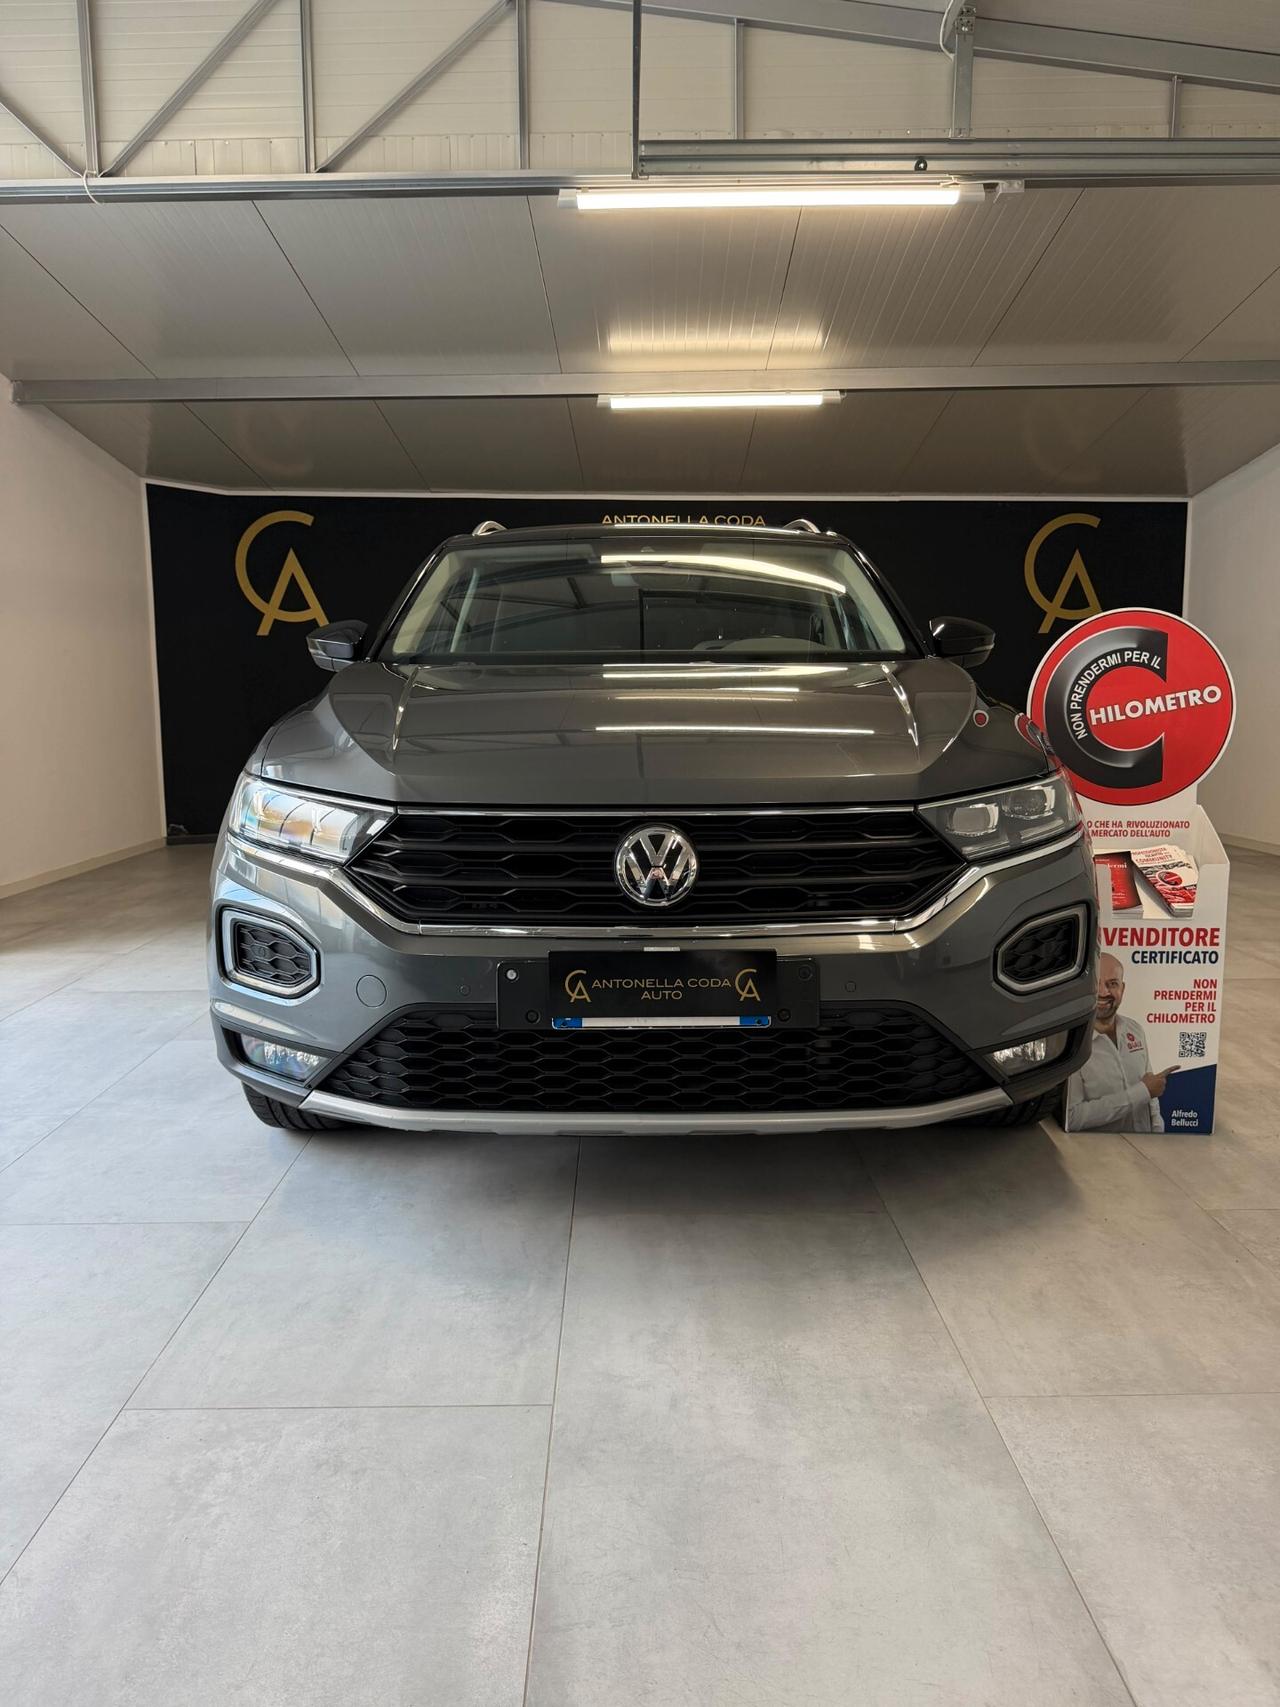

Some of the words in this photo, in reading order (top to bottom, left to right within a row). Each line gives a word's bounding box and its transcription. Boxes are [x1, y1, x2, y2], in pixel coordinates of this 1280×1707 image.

[714, 515, 766, 526] CODA
[1124, 650, 1150, 664] PER
[1150, 655, 1162, 671] IL
[1070, 652, 1122, 711] PRENDERMI
[1072, 712, 1088, 740] NON
[1094, 820, 1110, 828] CHE
[1112, 820, 1123, 828] HA
[1126, 820, 1190, 829] RIVOLUZIONATO
[1090, 829, 1129, 838] MERCATO
[1130, 829, 1171, 838] DELL'AUTO
[1103, 927, 1221, 947] VENDITORE
[1131, 950, 1219, 965] CERTIFICATO
[591, 978, 684, 989] ANTONELLA
[687, 978, 732, 988] CODA
[1193, 979, 1218, 989] NON
[641, 990, 683, 1000] AUTO
[1154, 990, 1217, 1001] PRENDERMI
[1185, 1002, 1205, 1012] PER
[1207, 1002, 1217, 1012] IL
[1146, 1013, 1216, 1024] CHILOMETRO
[1171, 1109, 1198, 1118] Alfredo
[1171, 1118, 1199, 1127] Bellucci
